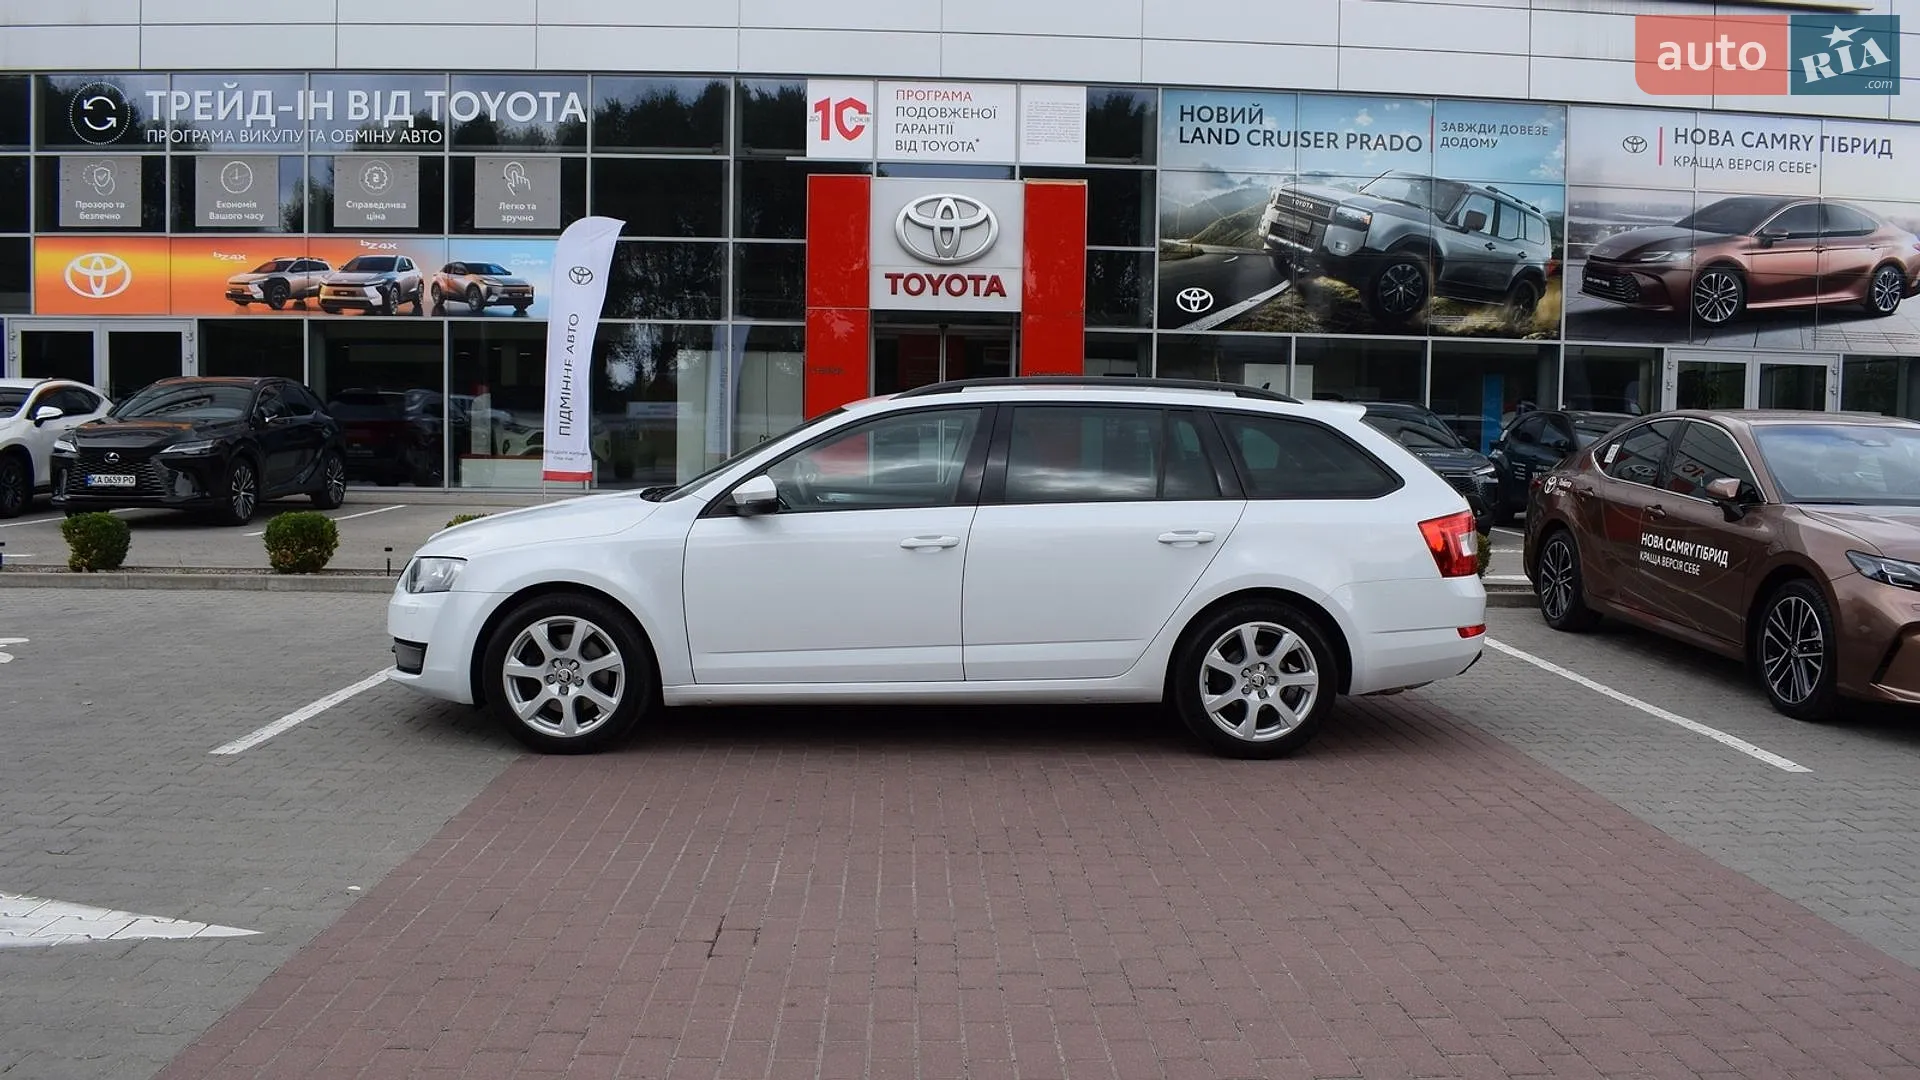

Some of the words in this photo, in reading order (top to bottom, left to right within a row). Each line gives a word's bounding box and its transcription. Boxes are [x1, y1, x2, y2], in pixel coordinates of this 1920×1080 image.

[896, 89, 973, 102] ПРОГРАМА
[145, 82, 334, 128] ТРЕЙД-ІН
[347, 89, 415, 128] ВІД
[424, 90, 587, 123] TOYOTA
[896, 105, 998, 120] ПОДОВЖЕНОЇ
[1179, 103, 1264, 125] НОВИЙ
[895, 121, 954, 135] ГАРАНТІЇ
[1440, 121, 1497, 136] ЗАВЖДИ
[1500, 124, 1549, 136] ДОВЕЗЕ
[147, 129, 235, 143] ПРОГРАМА
[239, 129, 304, 143] ВИКУПУ
[307, 129, 326, 143] ТА
[331, 129, 396, 144] ОБМІНУ
[399, 129, 442, 143] АВТО
[1179, 126, 1240, 146] LAND
[1246, 129, 1340, 150] CRUISER
[1346, 133, 1423, 153] PRADO
[1440, 136, 1498, 149] ДОДОМУ
[1674, 127, 1734, 147] НОВА
[1741, 131, 1814, 151] CAMRY
[1820, 135, 1893, 160] ГІБРИД
[895, 140, 918, 153] ВІД
[1673, 155, 1724, 171] КРАЩА
[1728, 157, 1774, 172] ВЕРСІЯ
[75, 201, 114, 210] Прозоро
[216, 201, 257, 210] Економія
[346, 201, 407, 211] Справедлива
[499, 202, 526, 211] Легко
[208, 211, 243, 221] Вашого
[244, 213, 265, 221] часу
[366, 212, 386, 222] ціна
[501, 215, 534, 223] зручно
[884, 272, 1007, 298] TOYOTA
[564, 313, 580, 355] АВТО
[559, 359, 573, 436] ПІДМІННЕ
[1641, 532, 1664, 550] НОВА
[1665, 538, 1696, 557] CAMRY
[1695, 544, 1729, 569] ГІБРИД
[1640, 551, 1661, 566] КРАЩА
[1683, 562, 1701, 576] СЕБЕ
